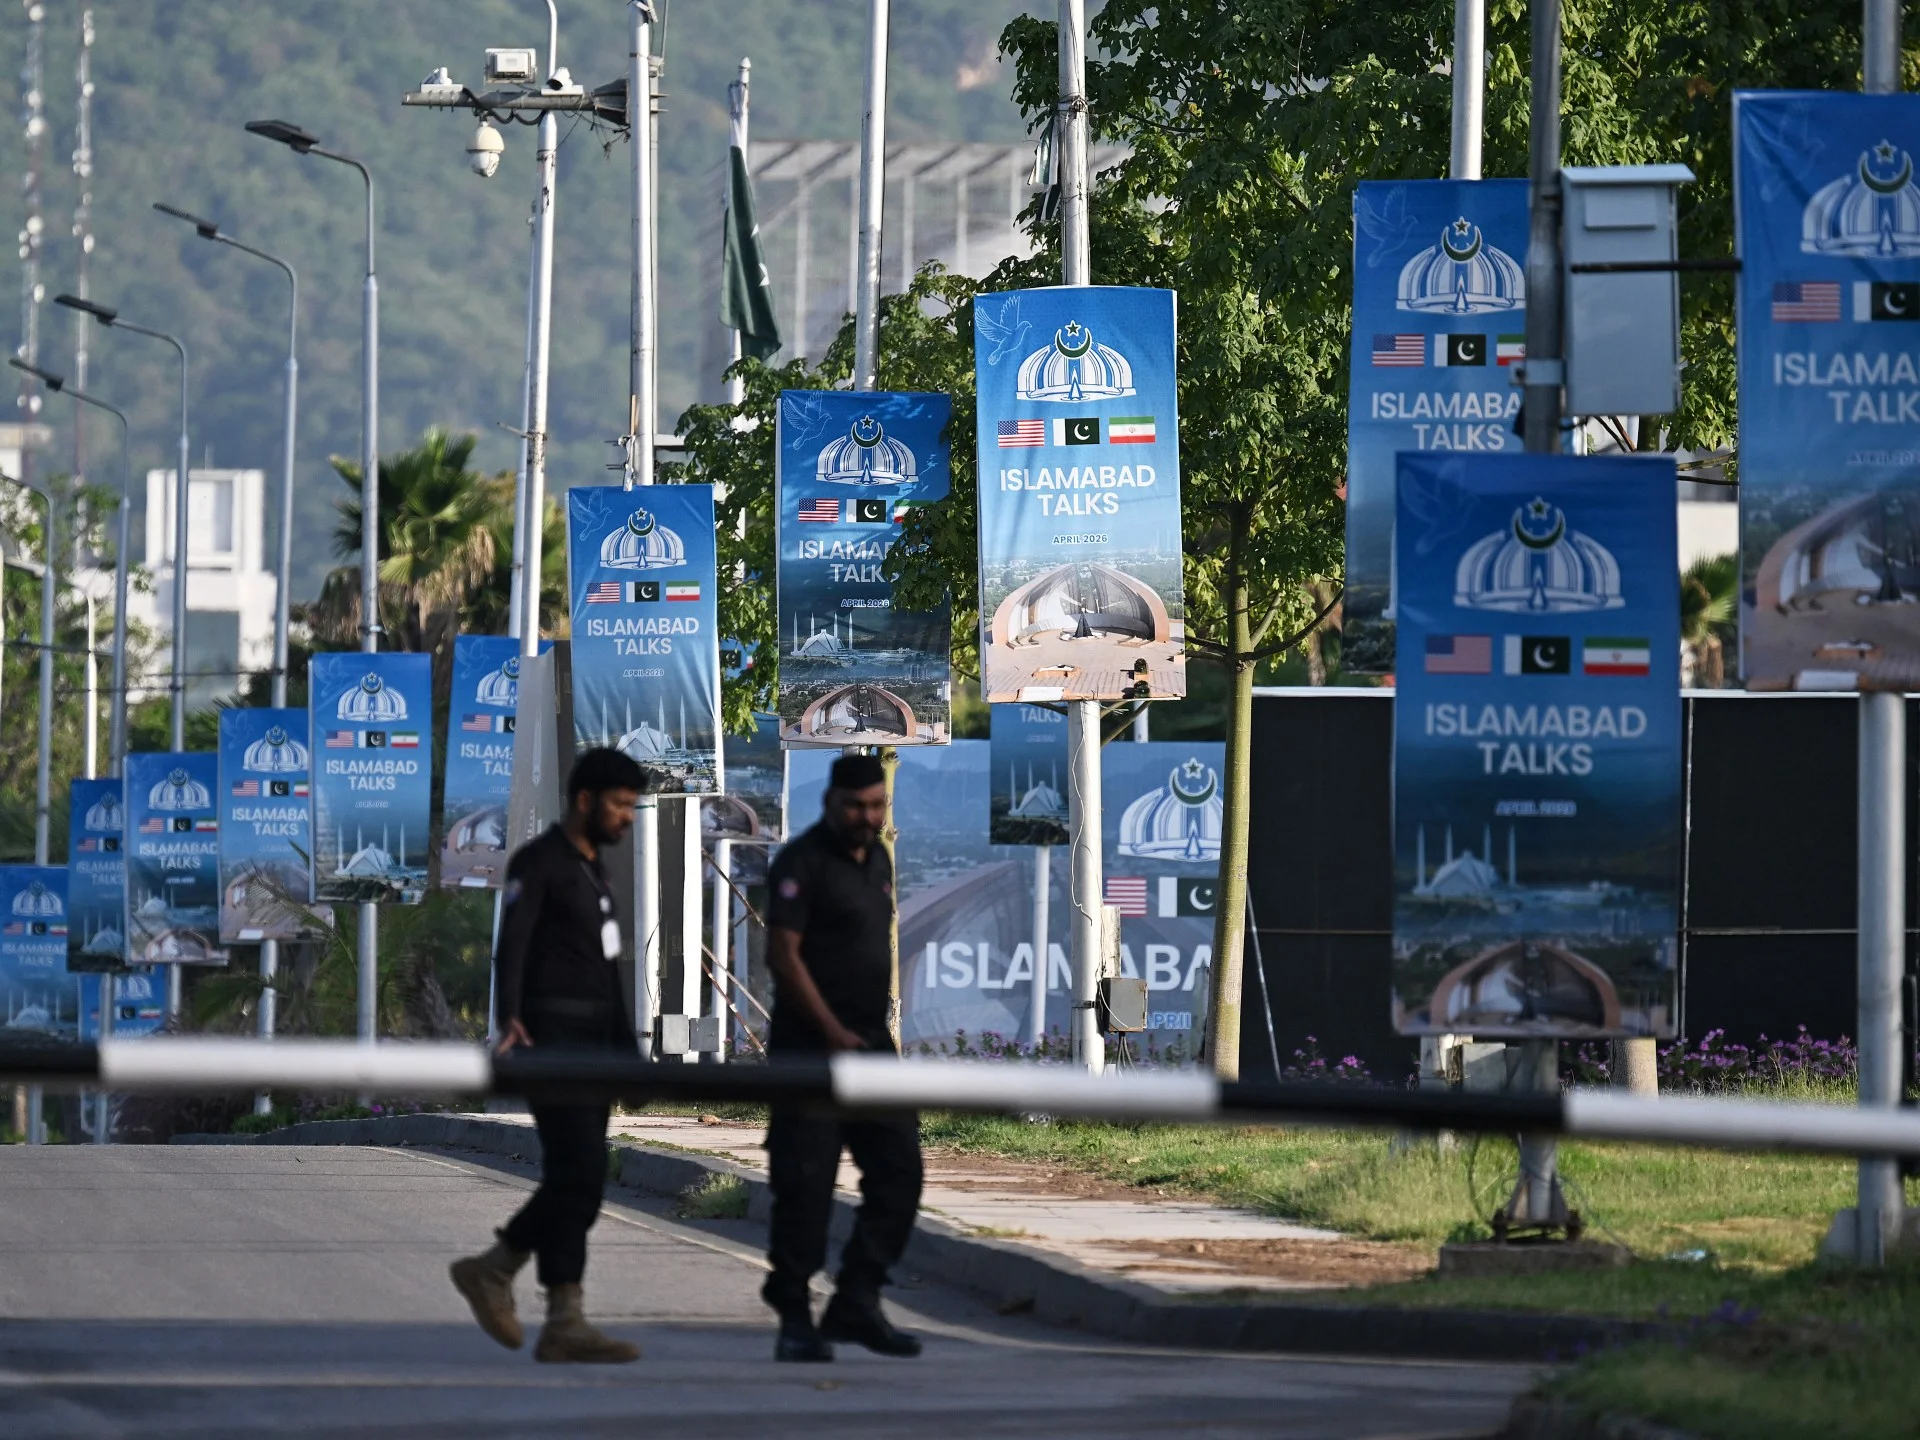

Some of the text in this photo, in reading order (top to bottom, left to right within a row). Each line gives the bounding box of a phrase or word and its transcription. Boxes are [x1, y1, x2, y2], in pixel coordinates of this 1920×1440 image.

[1773, 352, 1920, 386] ISLAMA
[1371, 392, 1522, 419] ISLAMABA
[1828, 391, 1920, 424] TALK
[1412, 423, 1505, 451] TALKS
[1000, 464, 1156, 492] ISLAMABAD
[1037, 492, 1120, 517] TALKS
[1052, 533, 1109, 545] APRIL 2026
[798, 539, 929, 560] ISLAMA
[840, 598, 890, 609] APRIL 2026
[587, 617, 700, 637] ISLAMABAD
[613, 636, 673, 656] TALKS
[623, 669, 644, 678] APRIL
[1425, 703, 1648, 739] ISLAMABAD
[460, 743, 513, 760] ISLAM
[1478, 741, 1594, 777] TALKS
[326, 760, 418, 775] ISLAMABAD
[482, 760, 512, 776] TAL
[347, 775, 396, 791] TALKS
[232, 807, 308, 821] ISLAMABA
[253, 821, 299, 836] TALKS
[158, 856, 201, 870] TALKS
